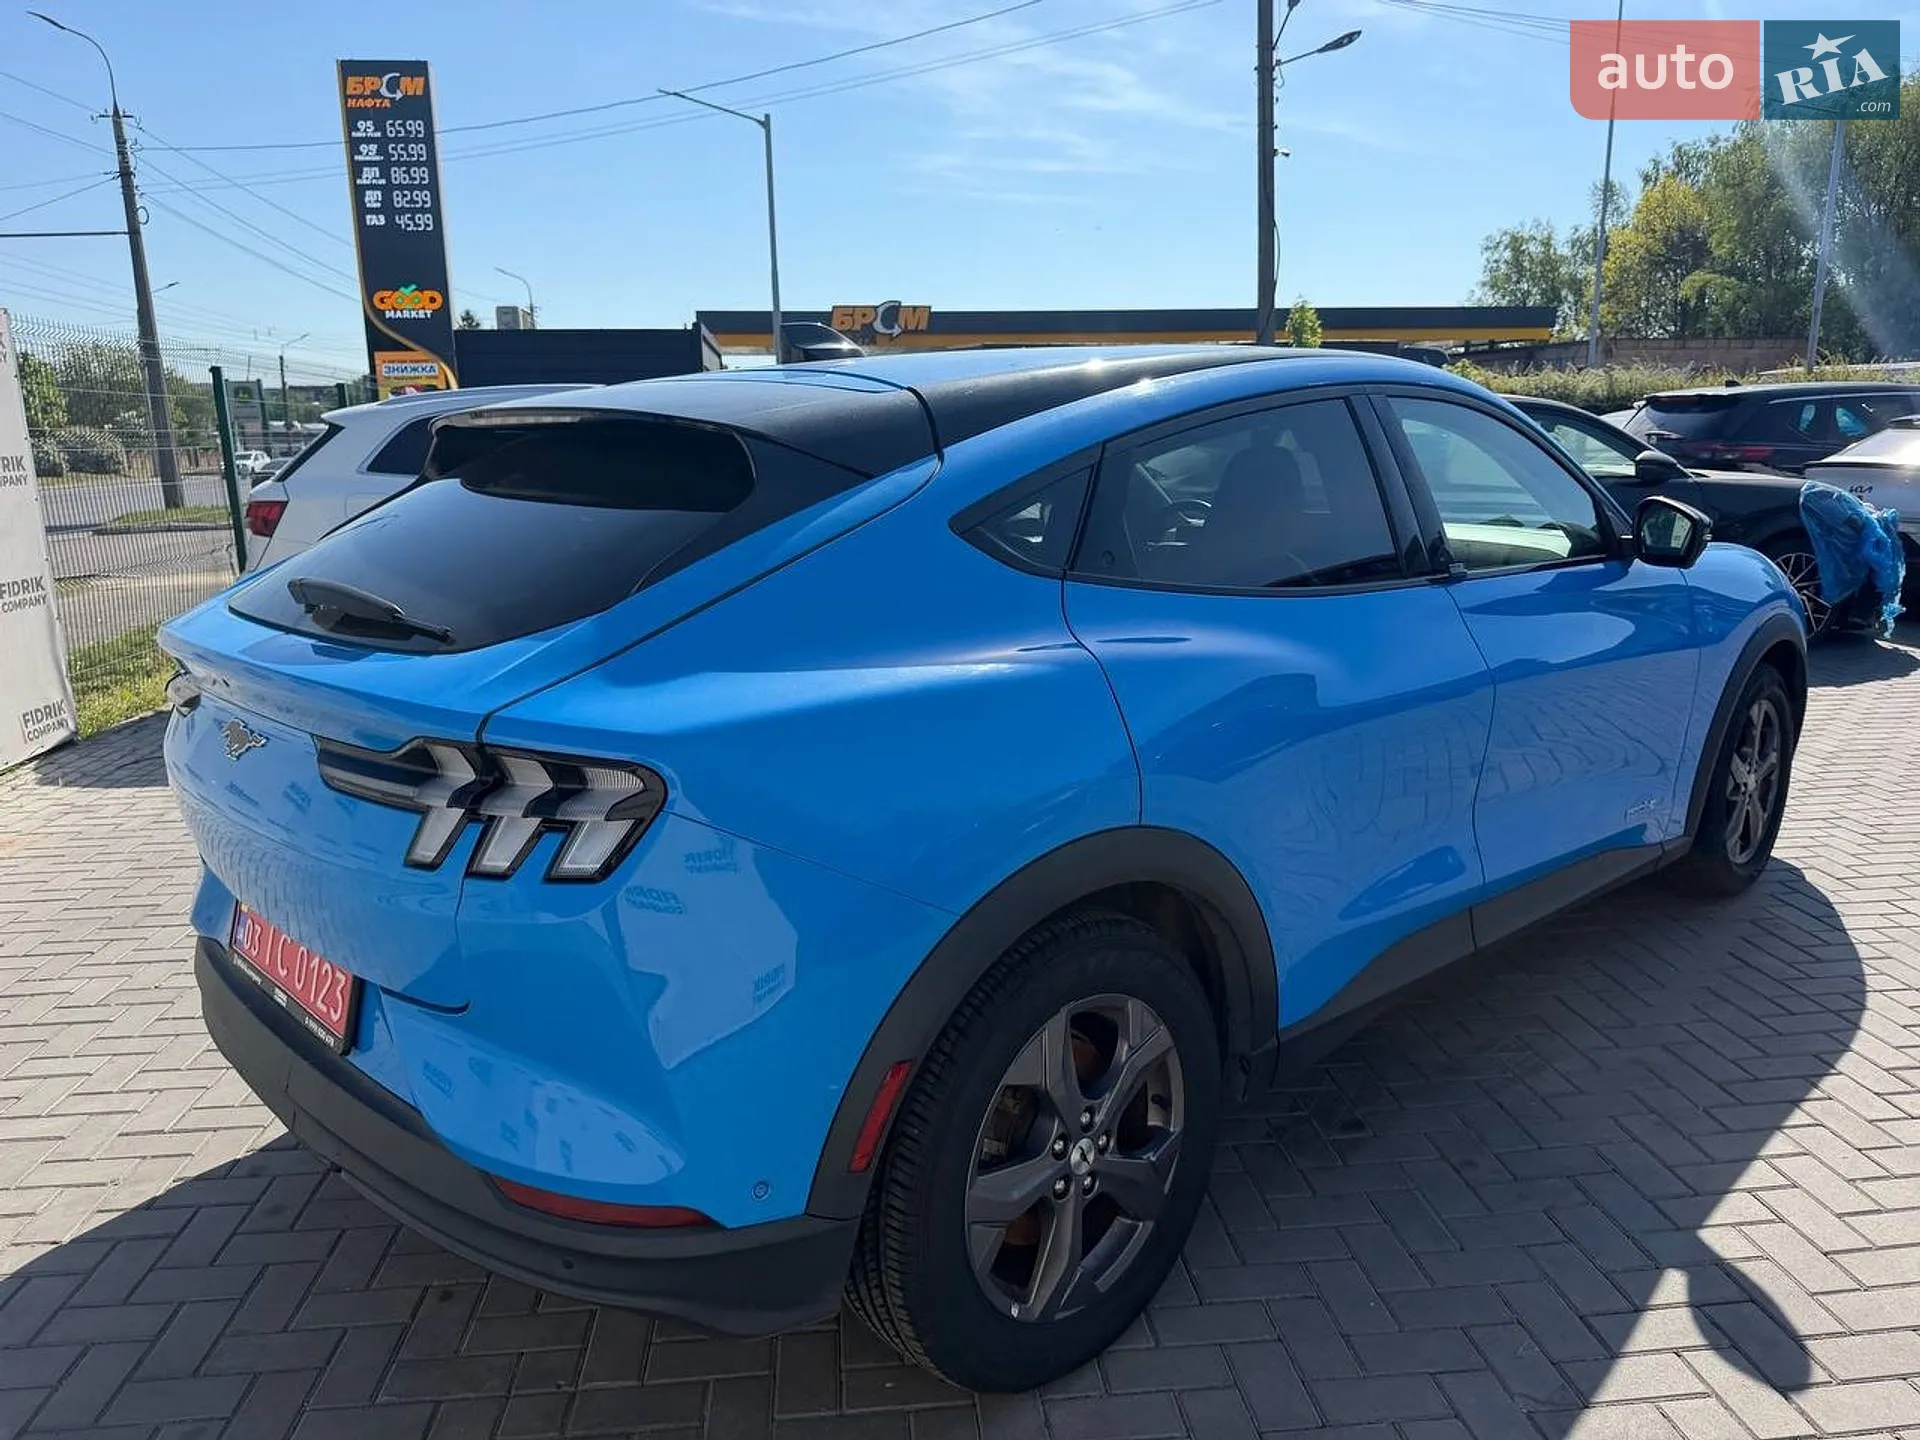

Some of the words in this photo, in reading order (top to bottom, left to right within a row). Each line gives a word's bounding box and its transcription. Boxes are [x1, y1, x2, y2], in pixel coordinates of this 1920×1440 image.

[345, 72, 425, 101] БРСМ
[347, 98, 392, 108] НАФТА
[357, 120, 375, 132] 95
[388, 143, 428, 162] 55.99
[390, 166, 429, 185] 86.99
[393, 190, 432, 209] 82.99
[365, 214, 386, 226] ГАЗ
[395, 213, 434, 231] 45.99
[373, 289, 443, 311] GOOD
[385, 310, 433, 320] MARKET
[831, 300, 931, 338] БРСМ
[383, 365, 437, 375] ЗНИЖКА
[0, 455, 26, 473] RIK
[0, 575, 46, 600] FIDRIK
[1, 594, 48, 613] COMPANY
[22, 698, 67, 730] FIDRIK
[27, 717, 69, 742] COMPANY
[243, 918, 263, 957] 03
[295, 945, 347, 1023] 0123
